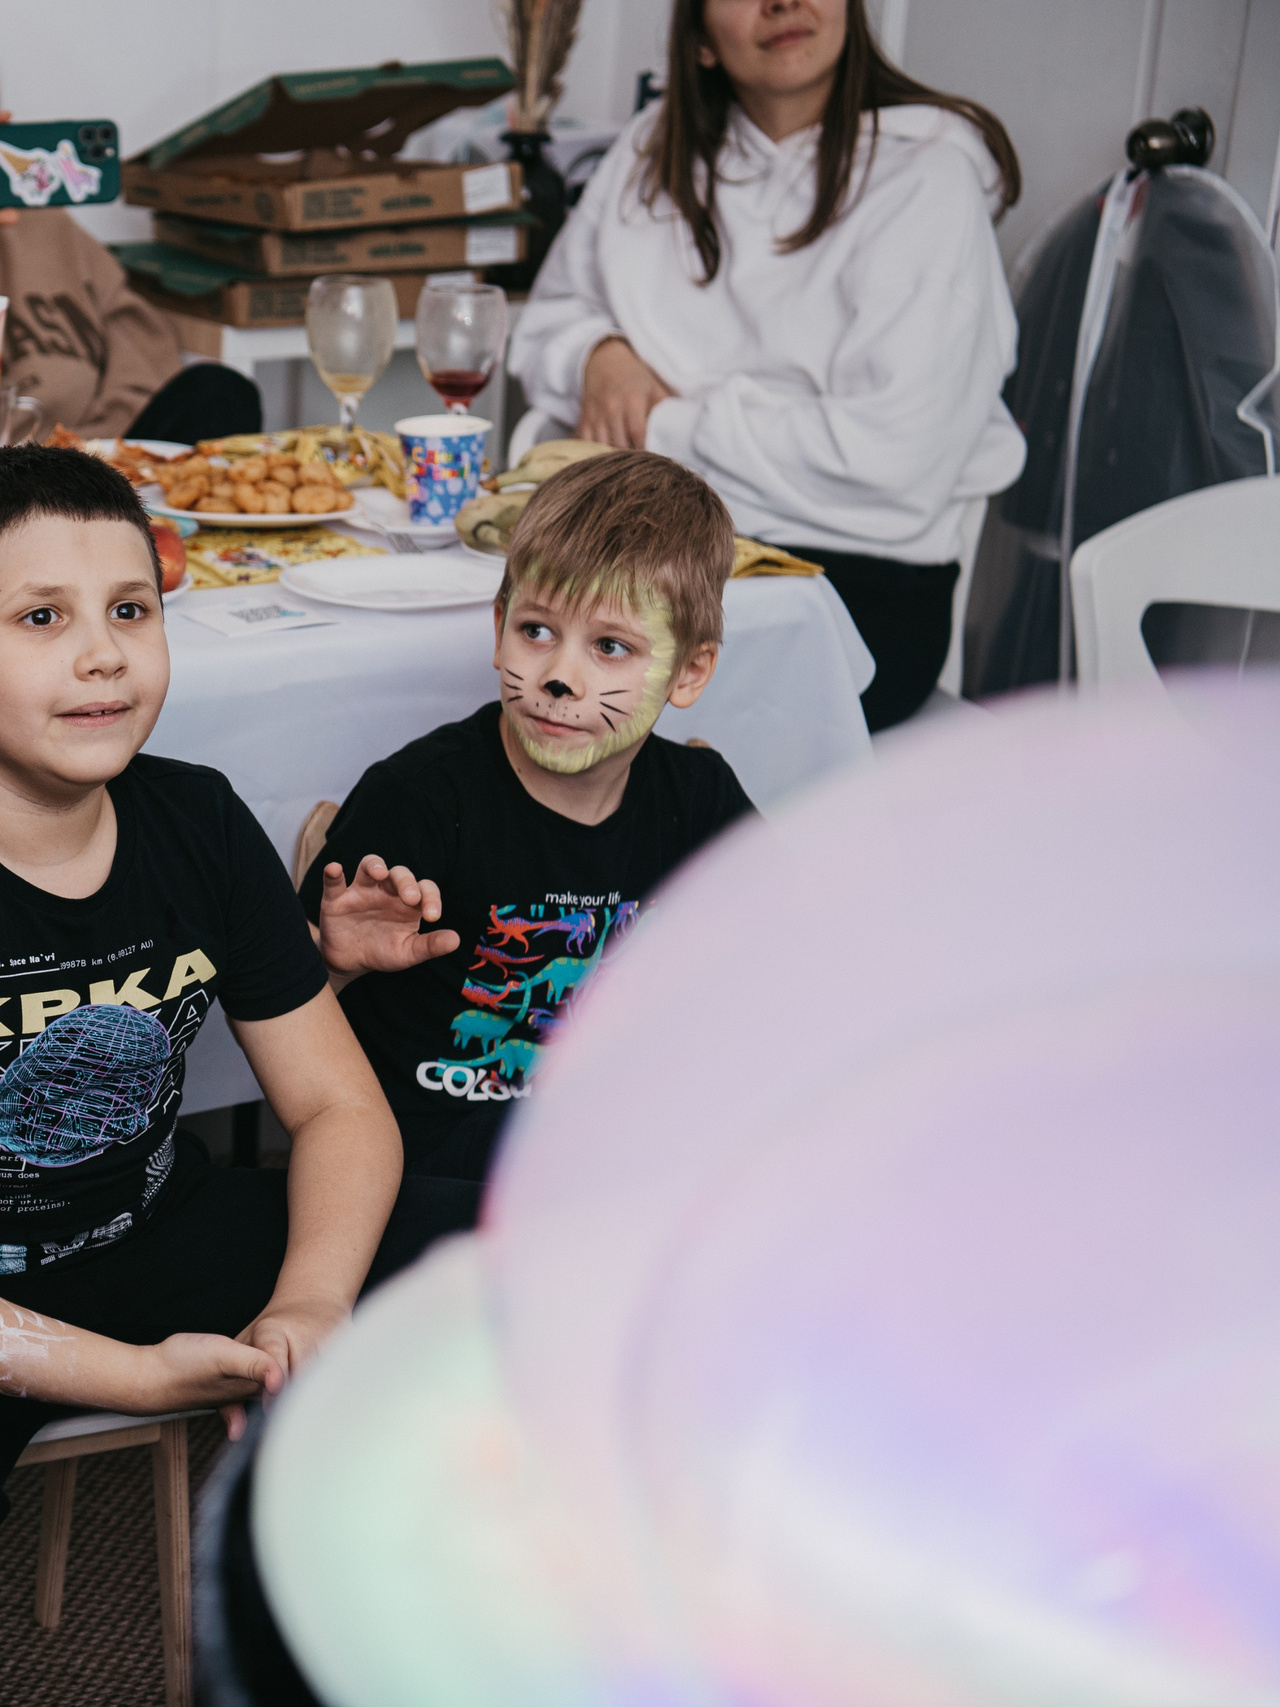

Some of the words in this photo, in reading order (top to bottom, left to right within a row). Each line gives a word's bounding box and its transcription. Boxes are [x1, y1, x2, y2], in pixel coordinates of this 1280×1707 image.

[545, 891, 578, 904] make
[579, 895, 605, 908] your
[608, 891, 621, 905] lif
[92, 958, 103, 966] km
[140, 939, 154, 950] AU)
[17, 1201, 71, 1213] proteins).
